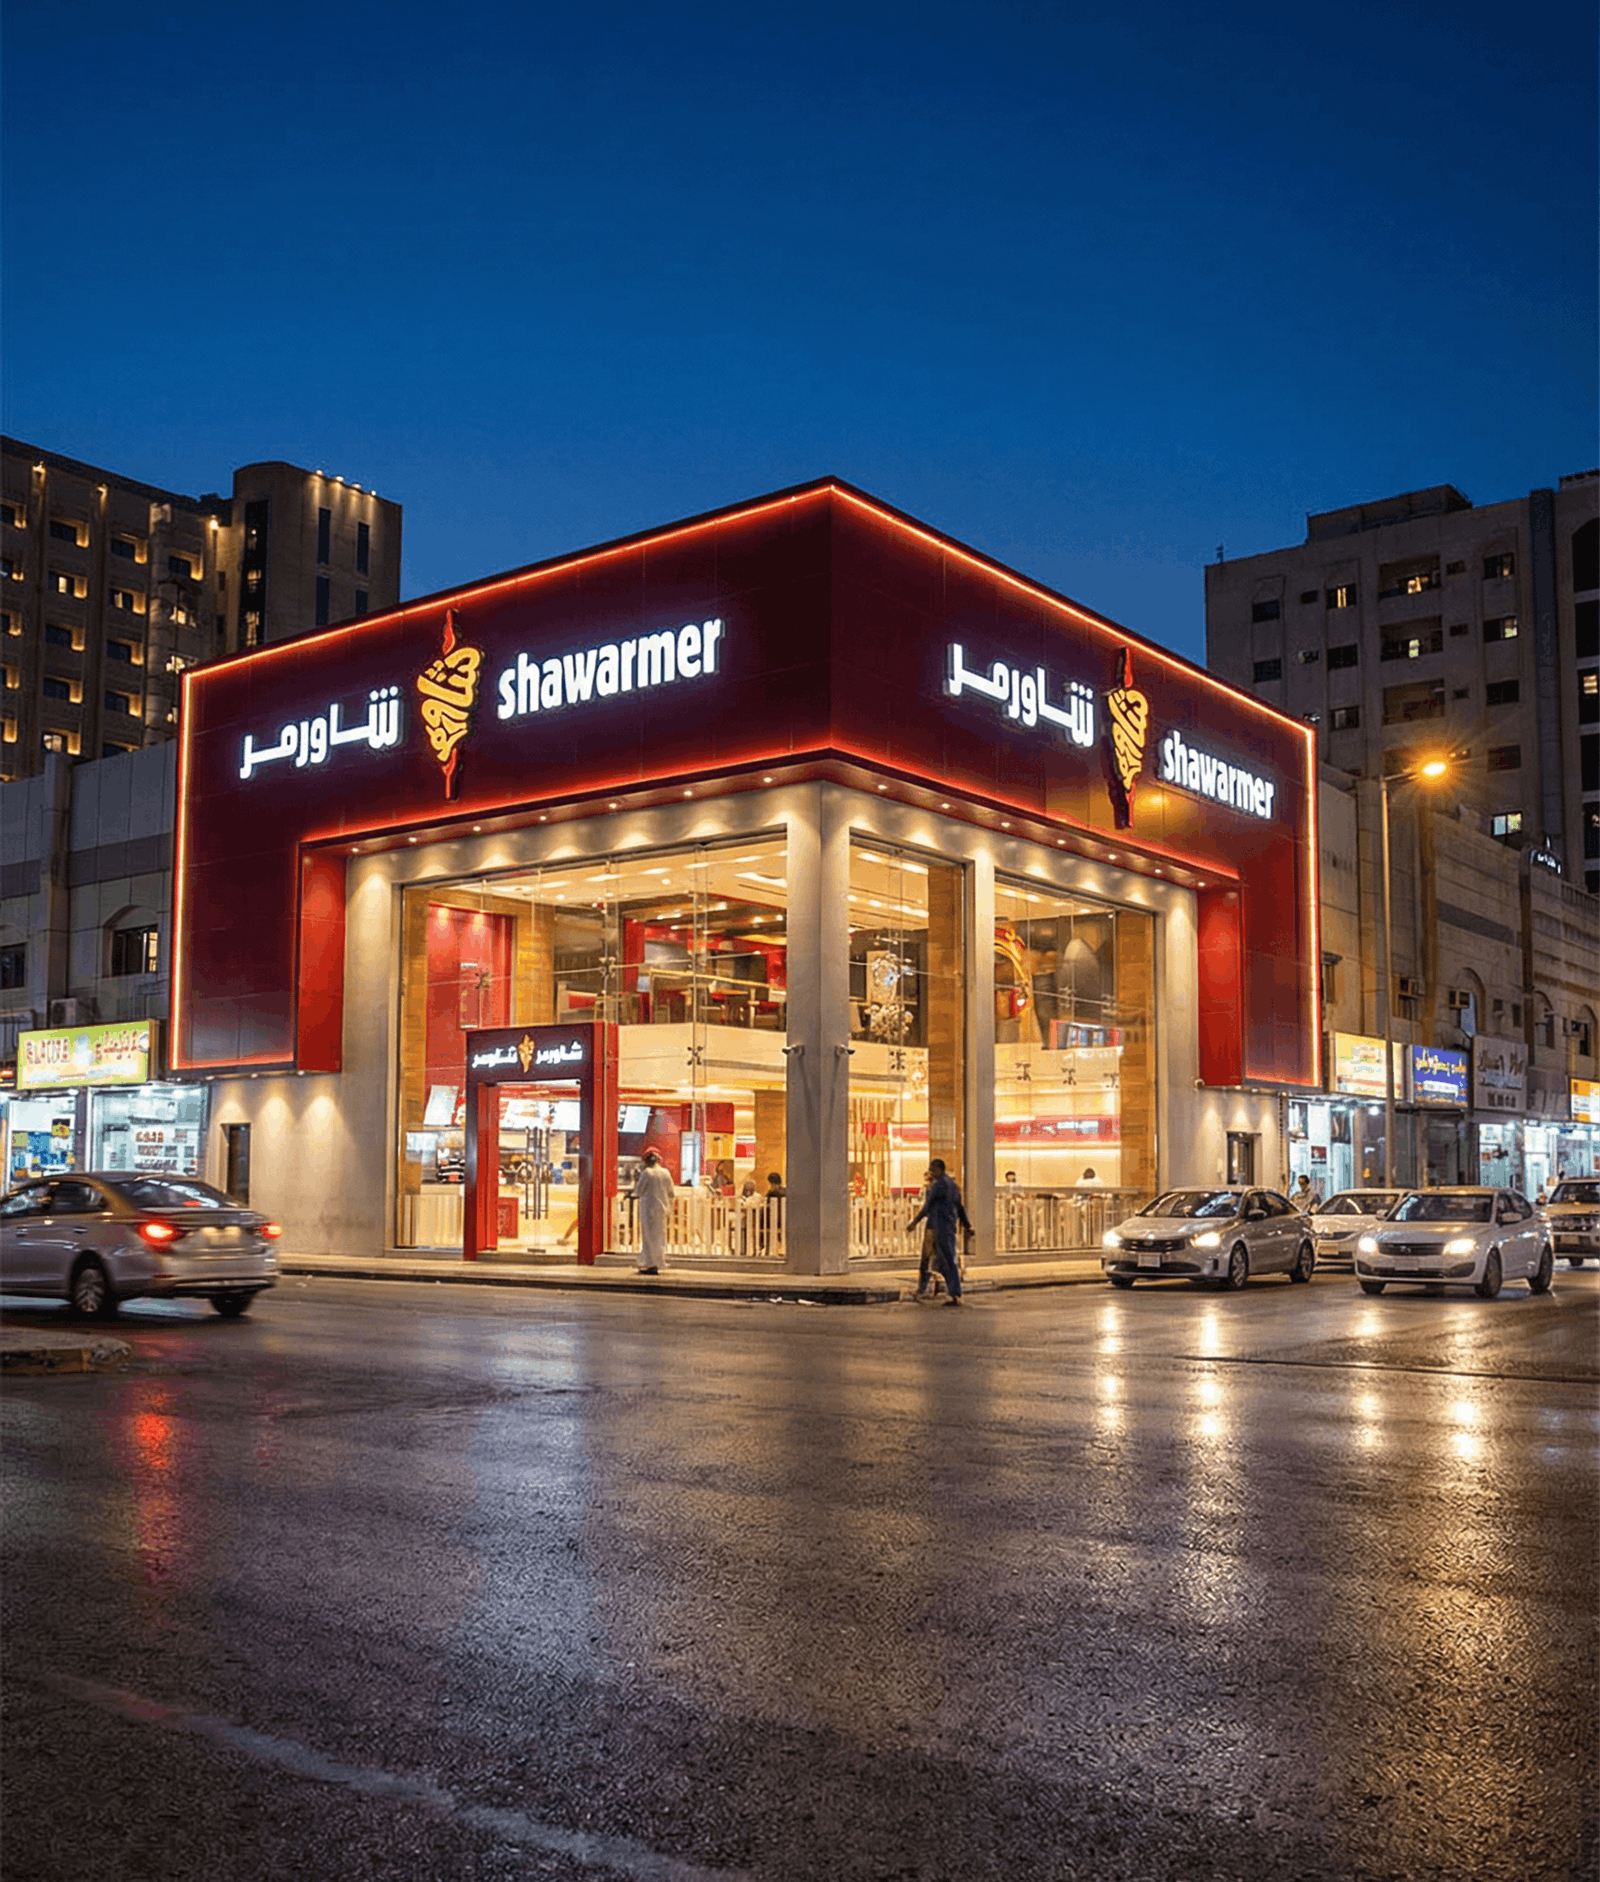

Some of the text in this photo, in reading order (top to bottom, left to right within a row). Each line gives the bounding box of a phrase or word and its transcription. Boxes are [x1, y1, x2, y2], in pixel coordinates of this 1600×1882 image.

[497, 618, 722, 720] shawarmer
[948, 643, 1094, 748] شاورمر
[239, 685, 399, 779] شاورمر
[1163, 730, 1275, 820] shawarmer
